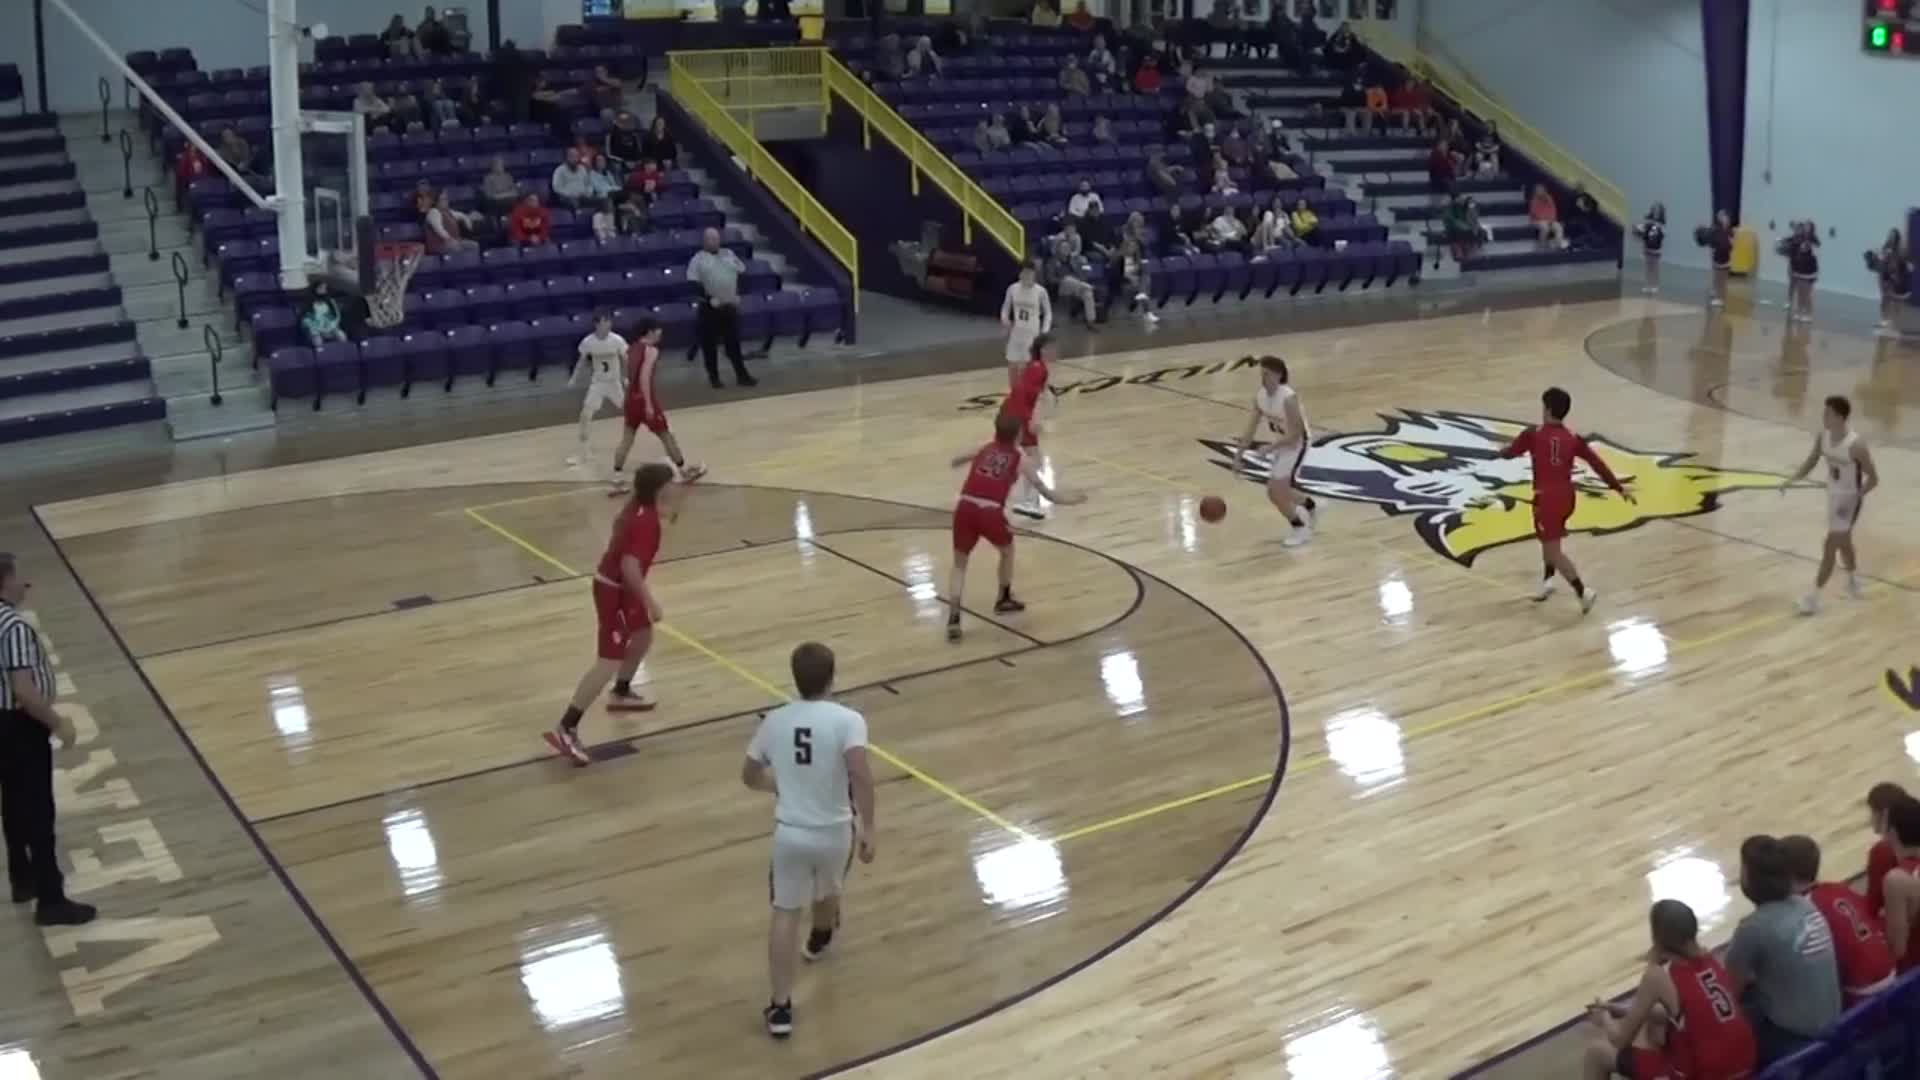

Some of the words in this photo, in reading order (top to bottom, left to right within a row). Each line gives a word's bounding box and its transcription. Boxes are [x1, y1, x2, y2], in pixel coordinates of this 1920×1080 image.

[957, 354, 1260, 411] WILDCAS
[793, 727, 813, 766] 5
[1696, 968, 1735, 1022] 5
